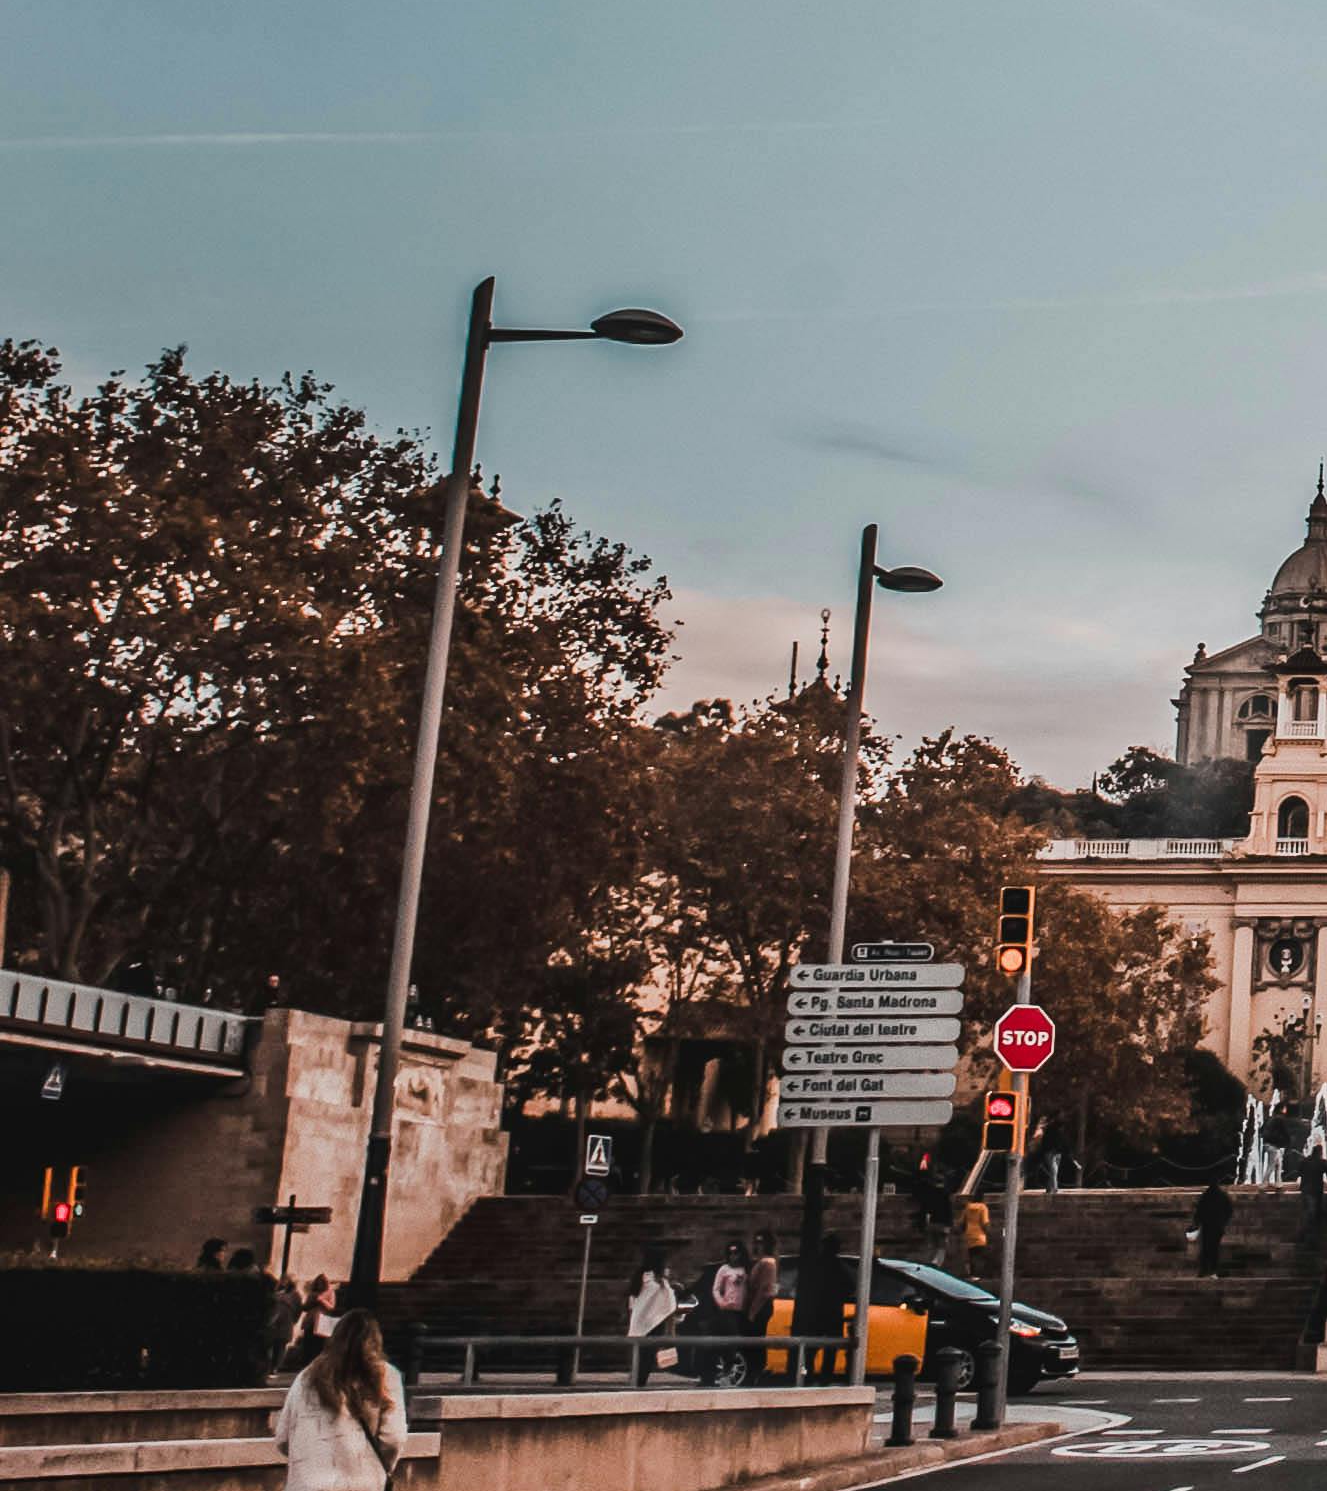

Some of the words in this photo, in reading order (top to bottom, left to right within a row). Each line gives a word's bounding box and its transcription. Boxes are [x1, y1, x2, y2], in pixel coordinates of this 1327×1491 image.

[869, 969, 917, 981] Urbana
[811, 995, 832, 1011] Pg.
[837, 995, 875, 1009] Santa
[878, 995, 937, 1009] Madrona
[809, 1023, 850, 1036] Ciutat
[853, 1022, 874, 1036] del
[878, 1023, 917, 1036] teatre
[1002, 1030, 1049, 1046] STOP
[805, 1050, 849, 1064] Teatre
[852, 1050, 884, 1064] Grec
[802, 1079, 833, 1092] Font
[836, 1078, 857, 1091] del
[860, 1078, 884, 1091] Gat
[800, 1107, 852, 1120] Museus
